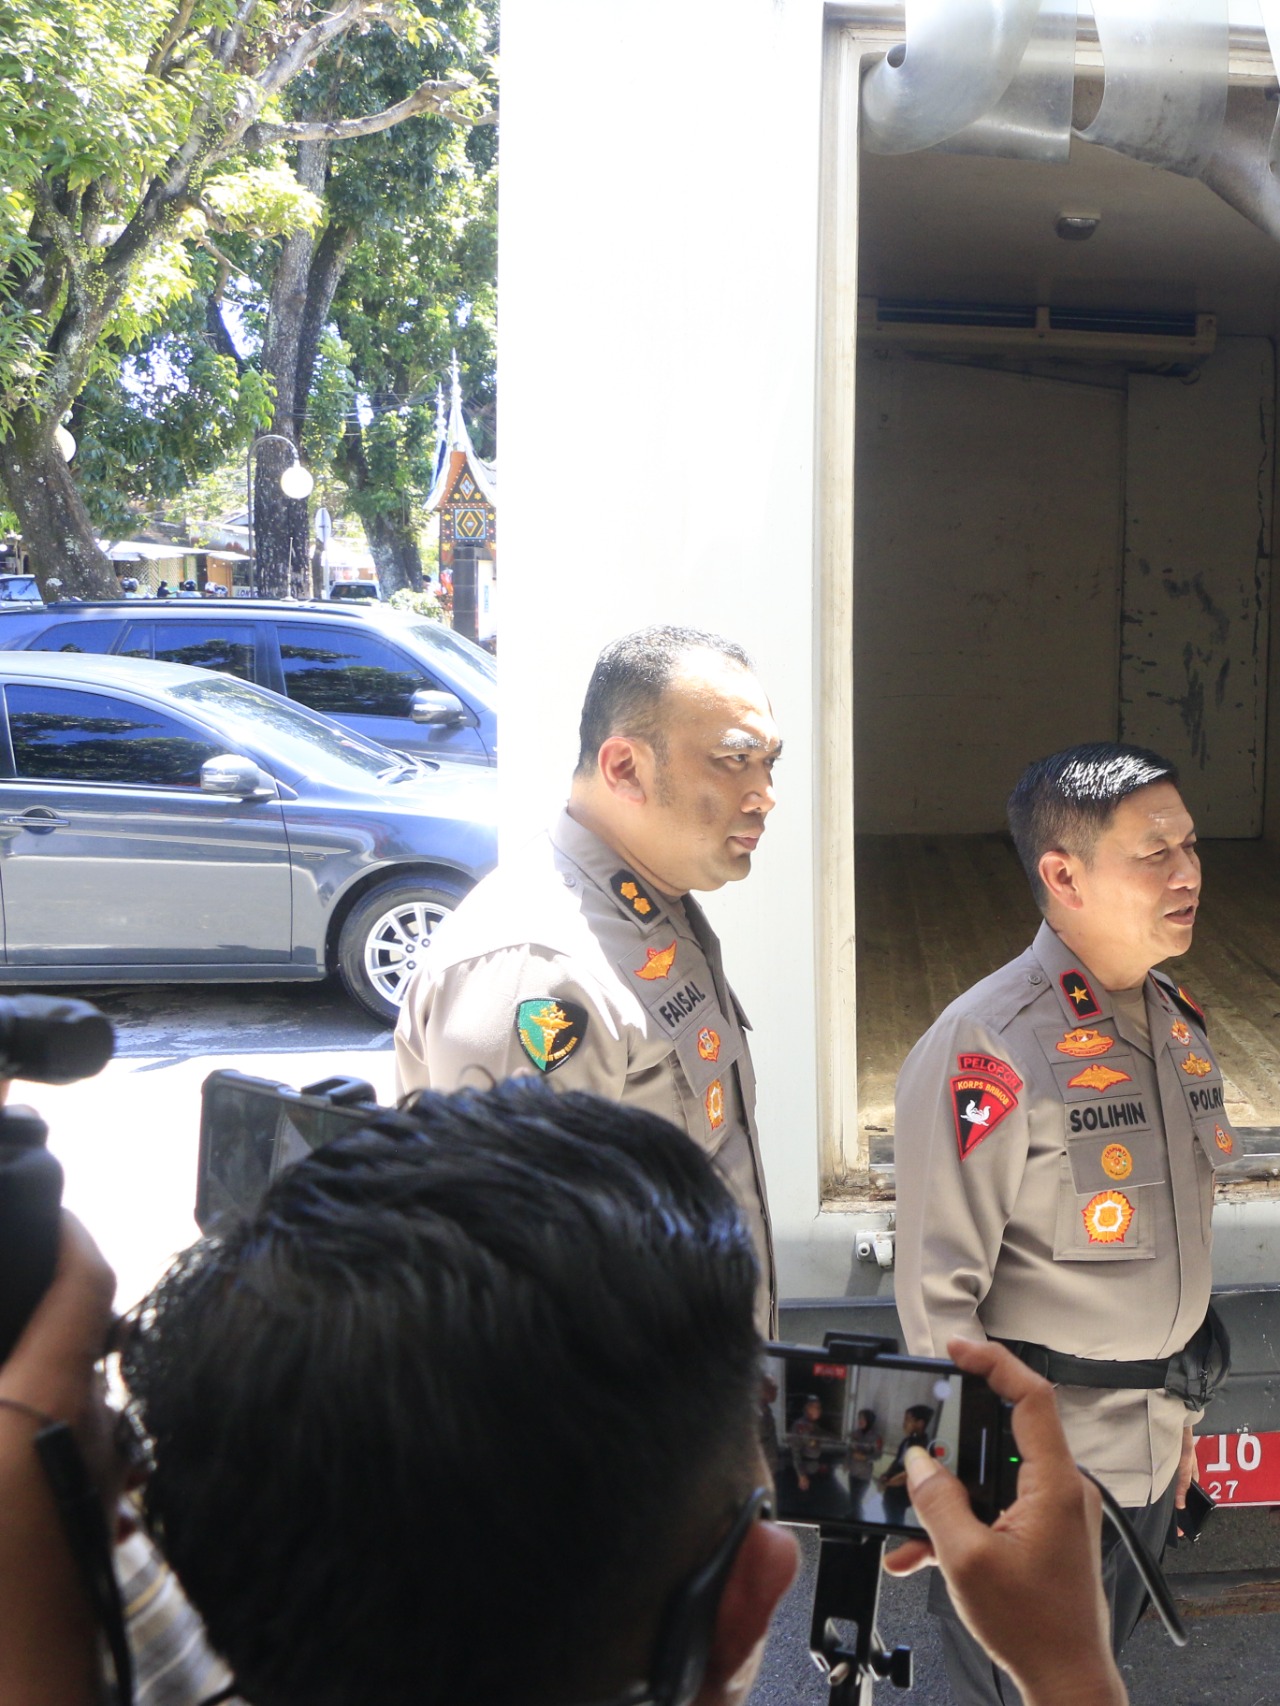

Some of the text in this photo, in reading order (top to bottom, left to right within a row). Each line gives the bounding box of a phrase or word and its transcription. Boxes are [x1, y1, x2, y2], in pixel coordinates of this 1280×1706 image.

[659, 981, 706, 1028] FAISAL
[957, 1080, 1010, 1106] KORPS BRIMOB
[1189, 1086, 1224, 1112] POLRI
[1069, 1101, 1147, 1133] SOLIHIN
[1193, 1433, 1262, 1472] 16
